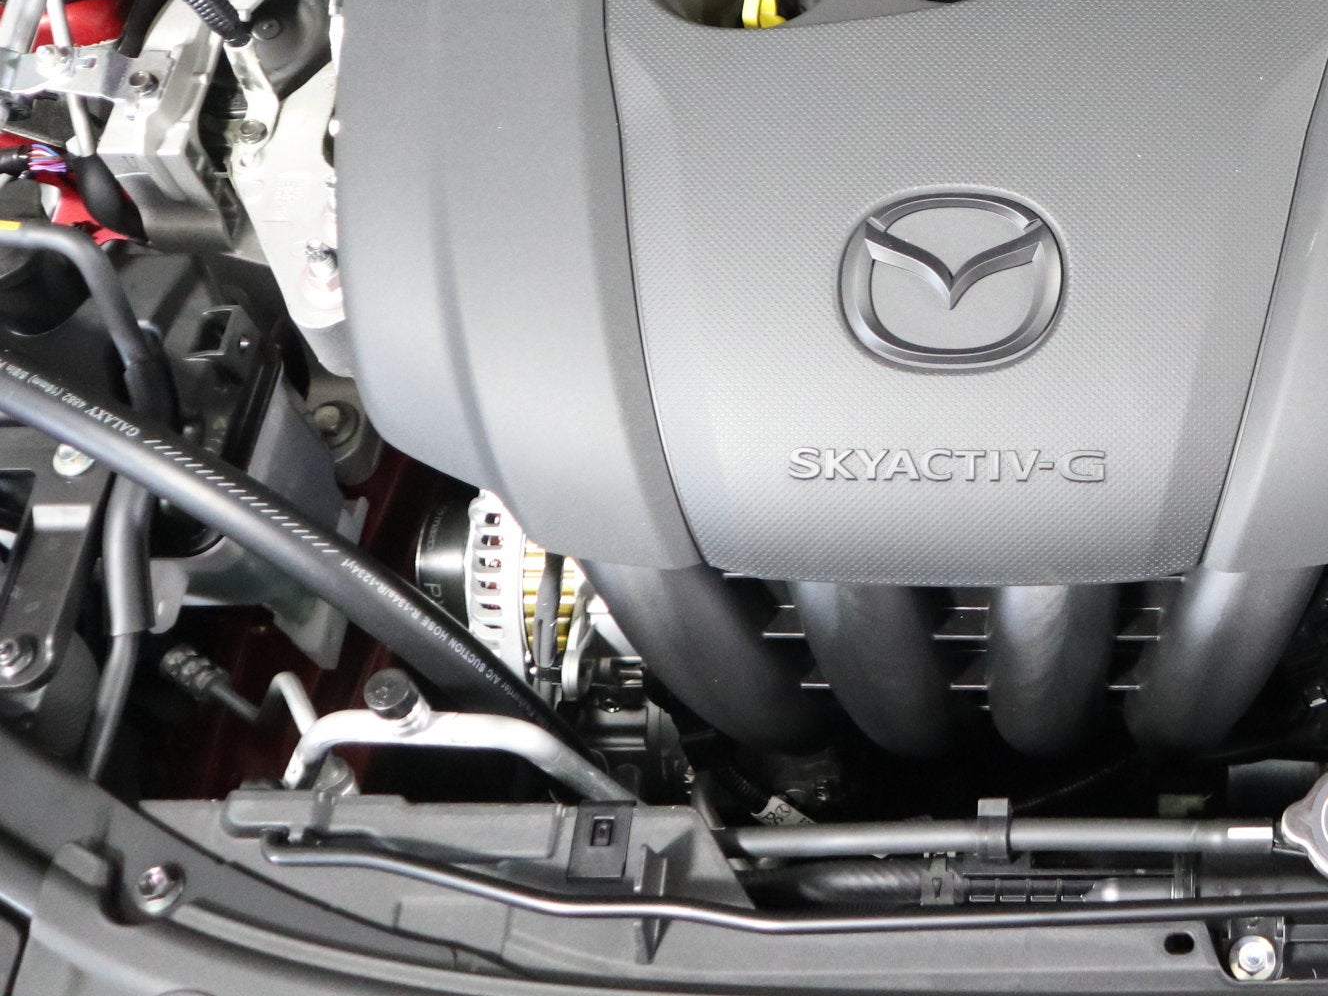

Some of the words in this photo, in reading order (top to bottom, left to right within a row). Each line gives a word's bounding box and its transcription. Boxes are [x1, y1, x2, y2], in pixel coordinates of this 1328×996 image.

[85, 406, 140, 437] GALAXY
[788, 446, 1106, 482] SKYACTIV-G
[421, 618, 450, 641] HOSE
[448, 638, 490, 674] SUCTION
